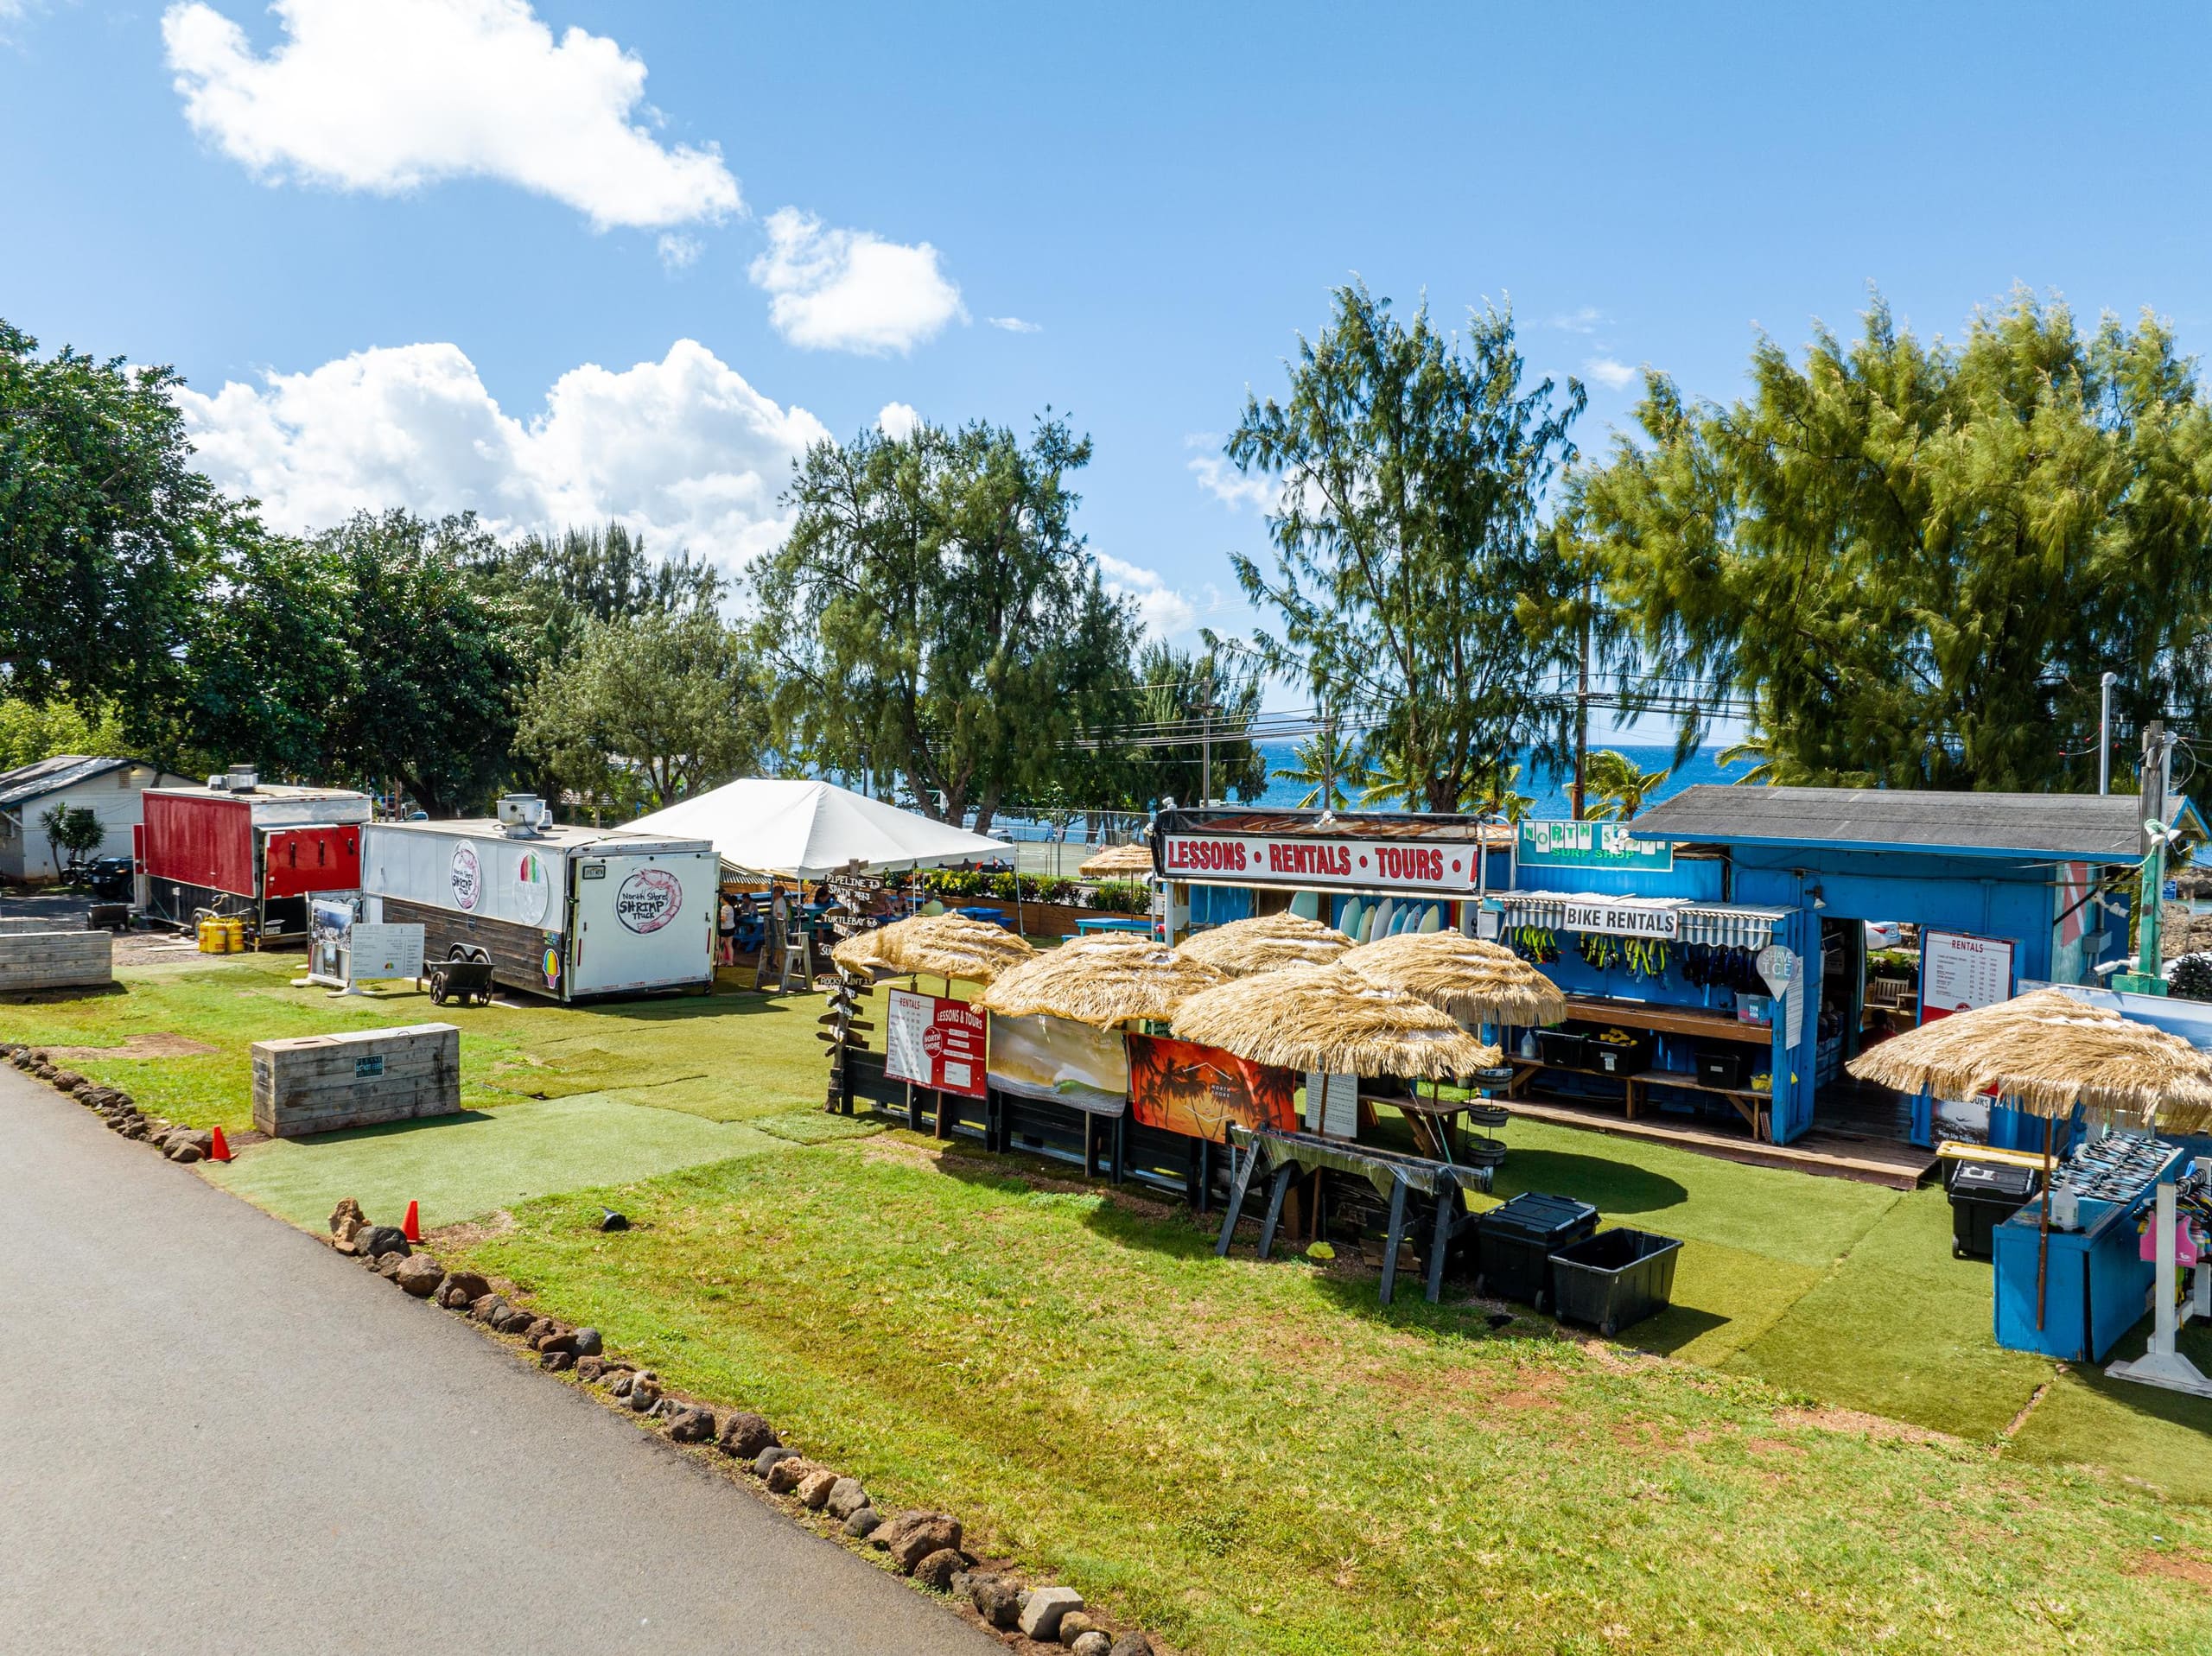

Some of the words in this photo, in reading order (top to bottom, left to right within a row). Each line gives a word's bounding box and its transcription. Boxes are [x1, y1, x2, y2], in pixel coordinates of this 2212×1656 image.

[1168, 841, 1247, 871] LESSONS
[1268, 843, 1351, 876] RENTALS
[1375, 847, 1444, 880] TOURS
[1552, 848, 1590, 858] SURF
[1594, 849, 1635, 859] SHOP
[826, 874, 866, 888] PIPELINE
[828, 885, 851, 898] SPAIN
[619, 900, 664, 914] SHRIMP
[823, 915, 865, 926] TURTLEBAY
[1567, 907, 1601, 927] BIKE
[1606, 911, 1675, 932] RENTALS
[1951, 939, 1984, 954] RENTALS
[1763, 951, 1792, 963] SHAVE
[1763, 961, 1791, 976] ICE
[899, 998, 920, 1010] RENTALS
[938, 1009, 959, 1023] LESSONS
[960, 1011, 964, 1024] &
[965, 1012, 982, 1030] TOURS
